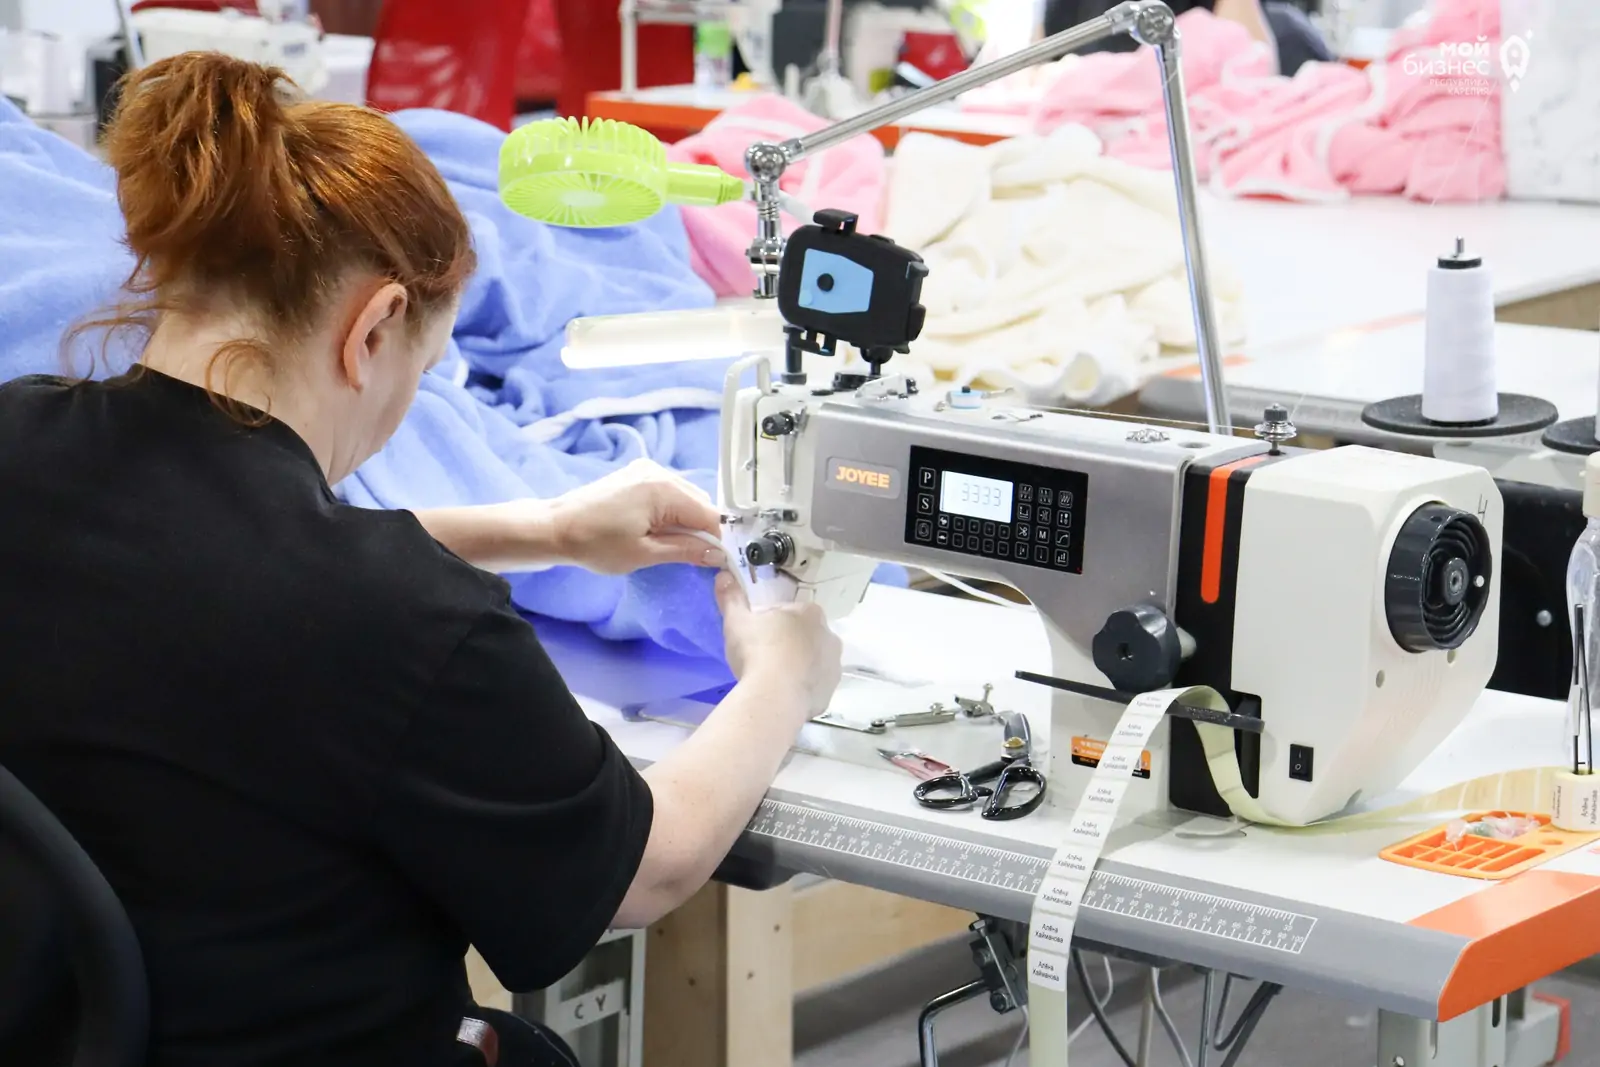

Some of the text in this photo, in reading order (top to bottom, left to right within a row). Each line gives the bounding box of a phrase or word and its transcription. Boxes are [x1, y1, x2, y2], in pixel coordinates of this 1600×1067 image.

[835, 466, 890, 488] JOYEE
[923, 471, 931, 484] P
[921, 497, 929, 510] S
[1038, 530, 1046, 539] M
